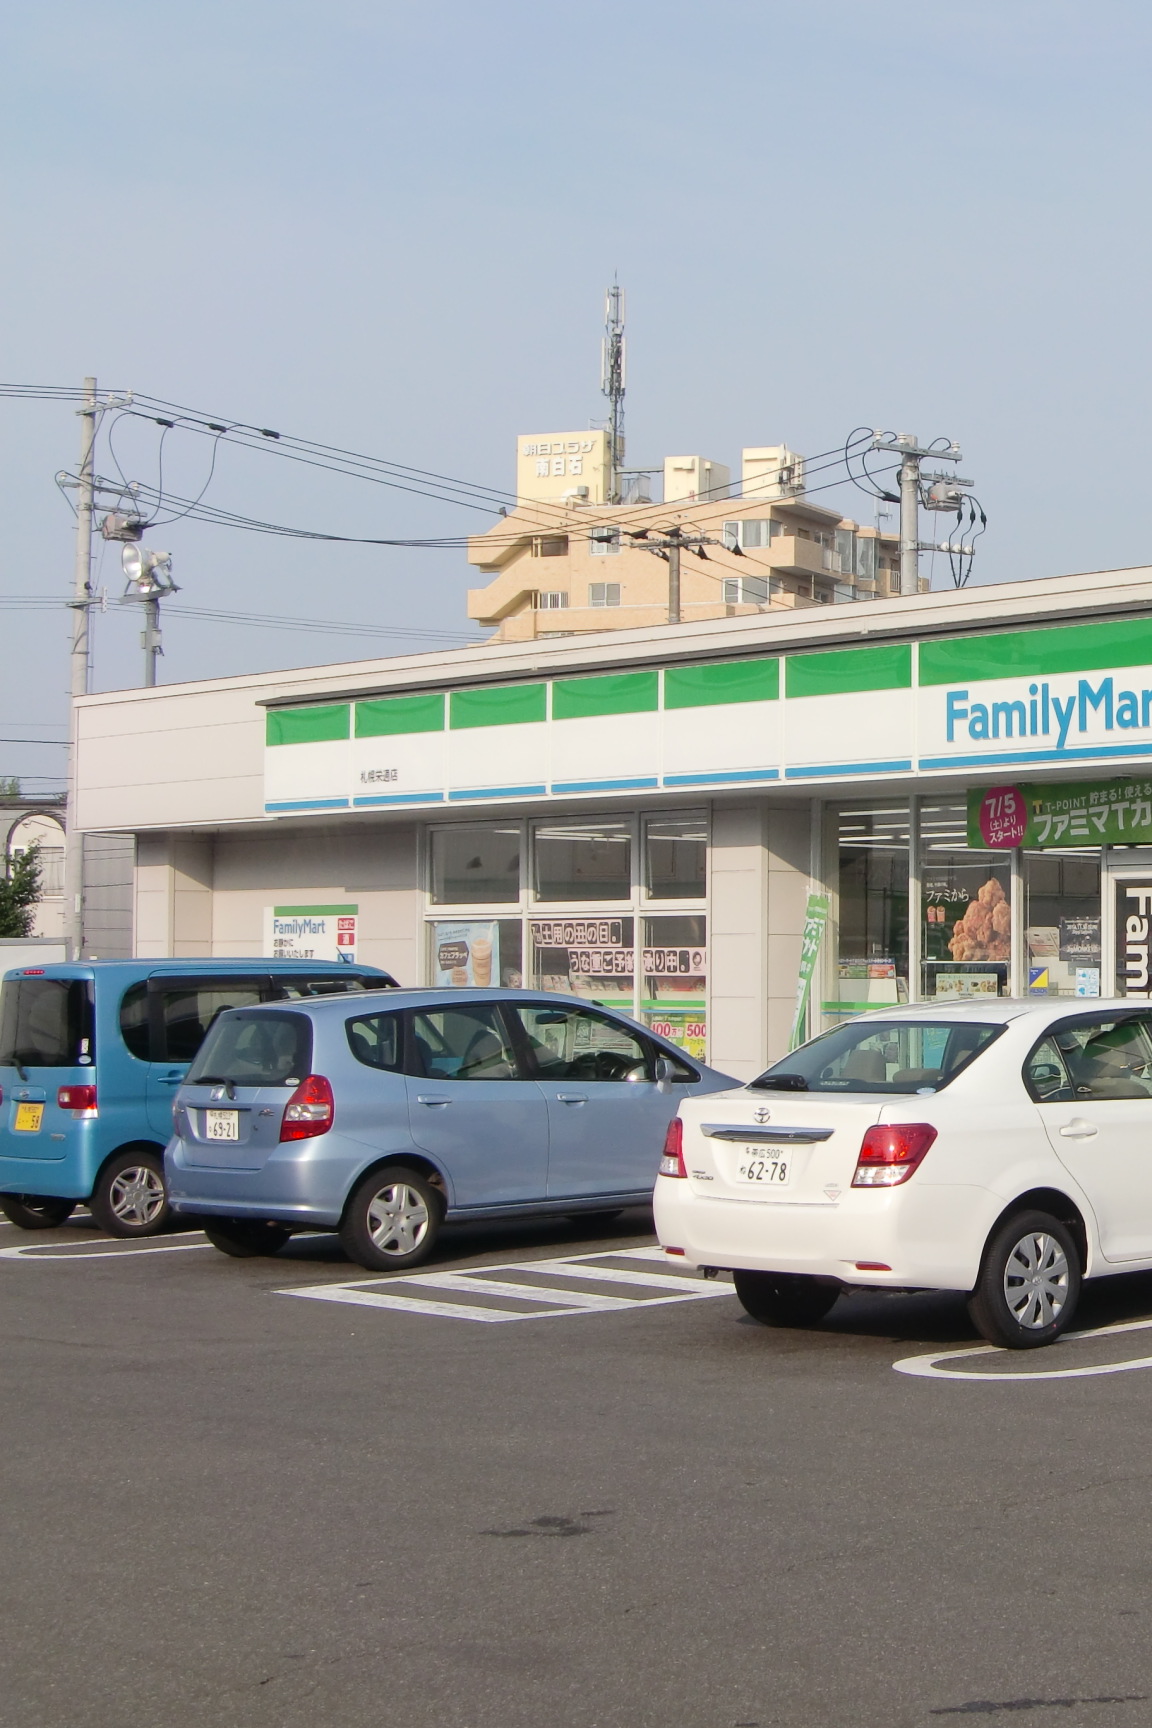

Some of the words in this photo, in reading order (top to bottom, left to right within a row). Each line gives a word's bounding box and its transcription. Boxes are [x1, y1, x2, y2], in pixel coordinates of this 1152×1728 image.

[536, 455, 583, 477] 南白石
[985, 793, 1016, 819] 7/5
[1045, 796, 1087, 811] T-POINT
[1089, 791, 1122, 805] 貯まる!
[989, 816, 1017, 831] (土)より
[989, 826, 1024, 844] スタート!!
[926, 888, 969, 903] ファミから
[273, 919, 326, 938] FamilyMart
